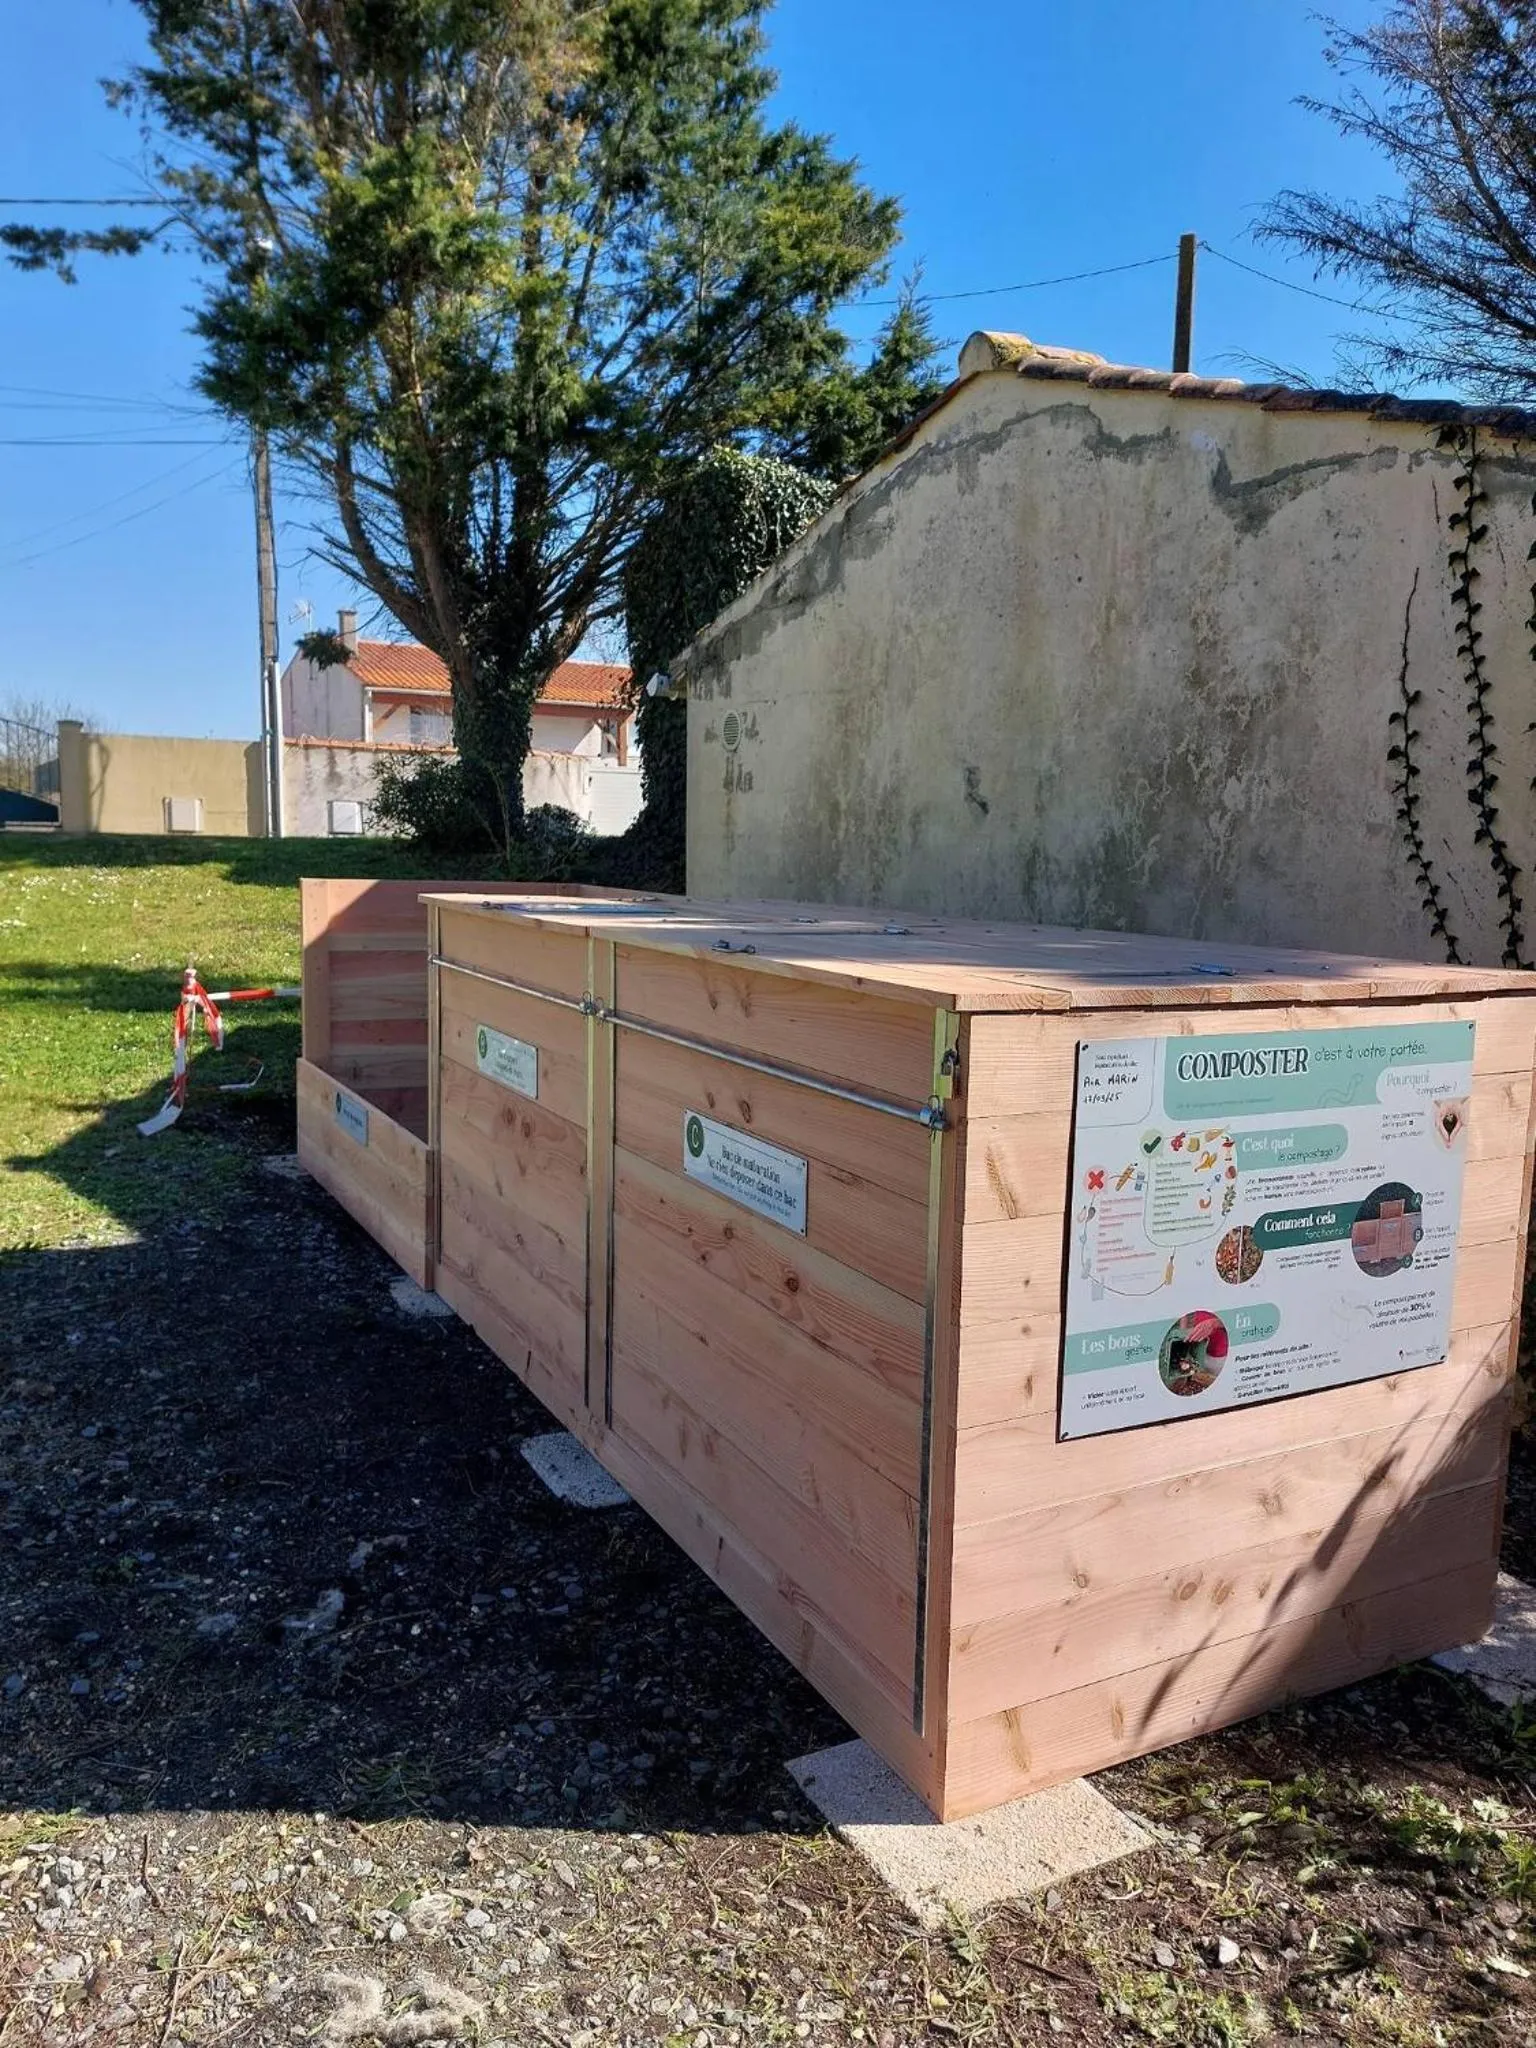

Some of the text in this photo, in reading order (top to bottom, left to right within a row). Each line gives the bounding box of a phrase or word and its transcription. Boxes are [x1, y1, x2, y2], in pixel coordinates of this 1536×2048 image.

[1178, 1047, 1308, 1080] COMPOSTER
[1315, 1045, 1342, 1062] c'est
[1358, 1042, 1387, 1059] votre
[1386, 1070, 1430, 1089] Pourquoi
[1271, 1134, 1295, 1153] quoi
[1264, 1216, 1314, 1232] Comment
[1081, 1333, 1141, 1355] Les bons
